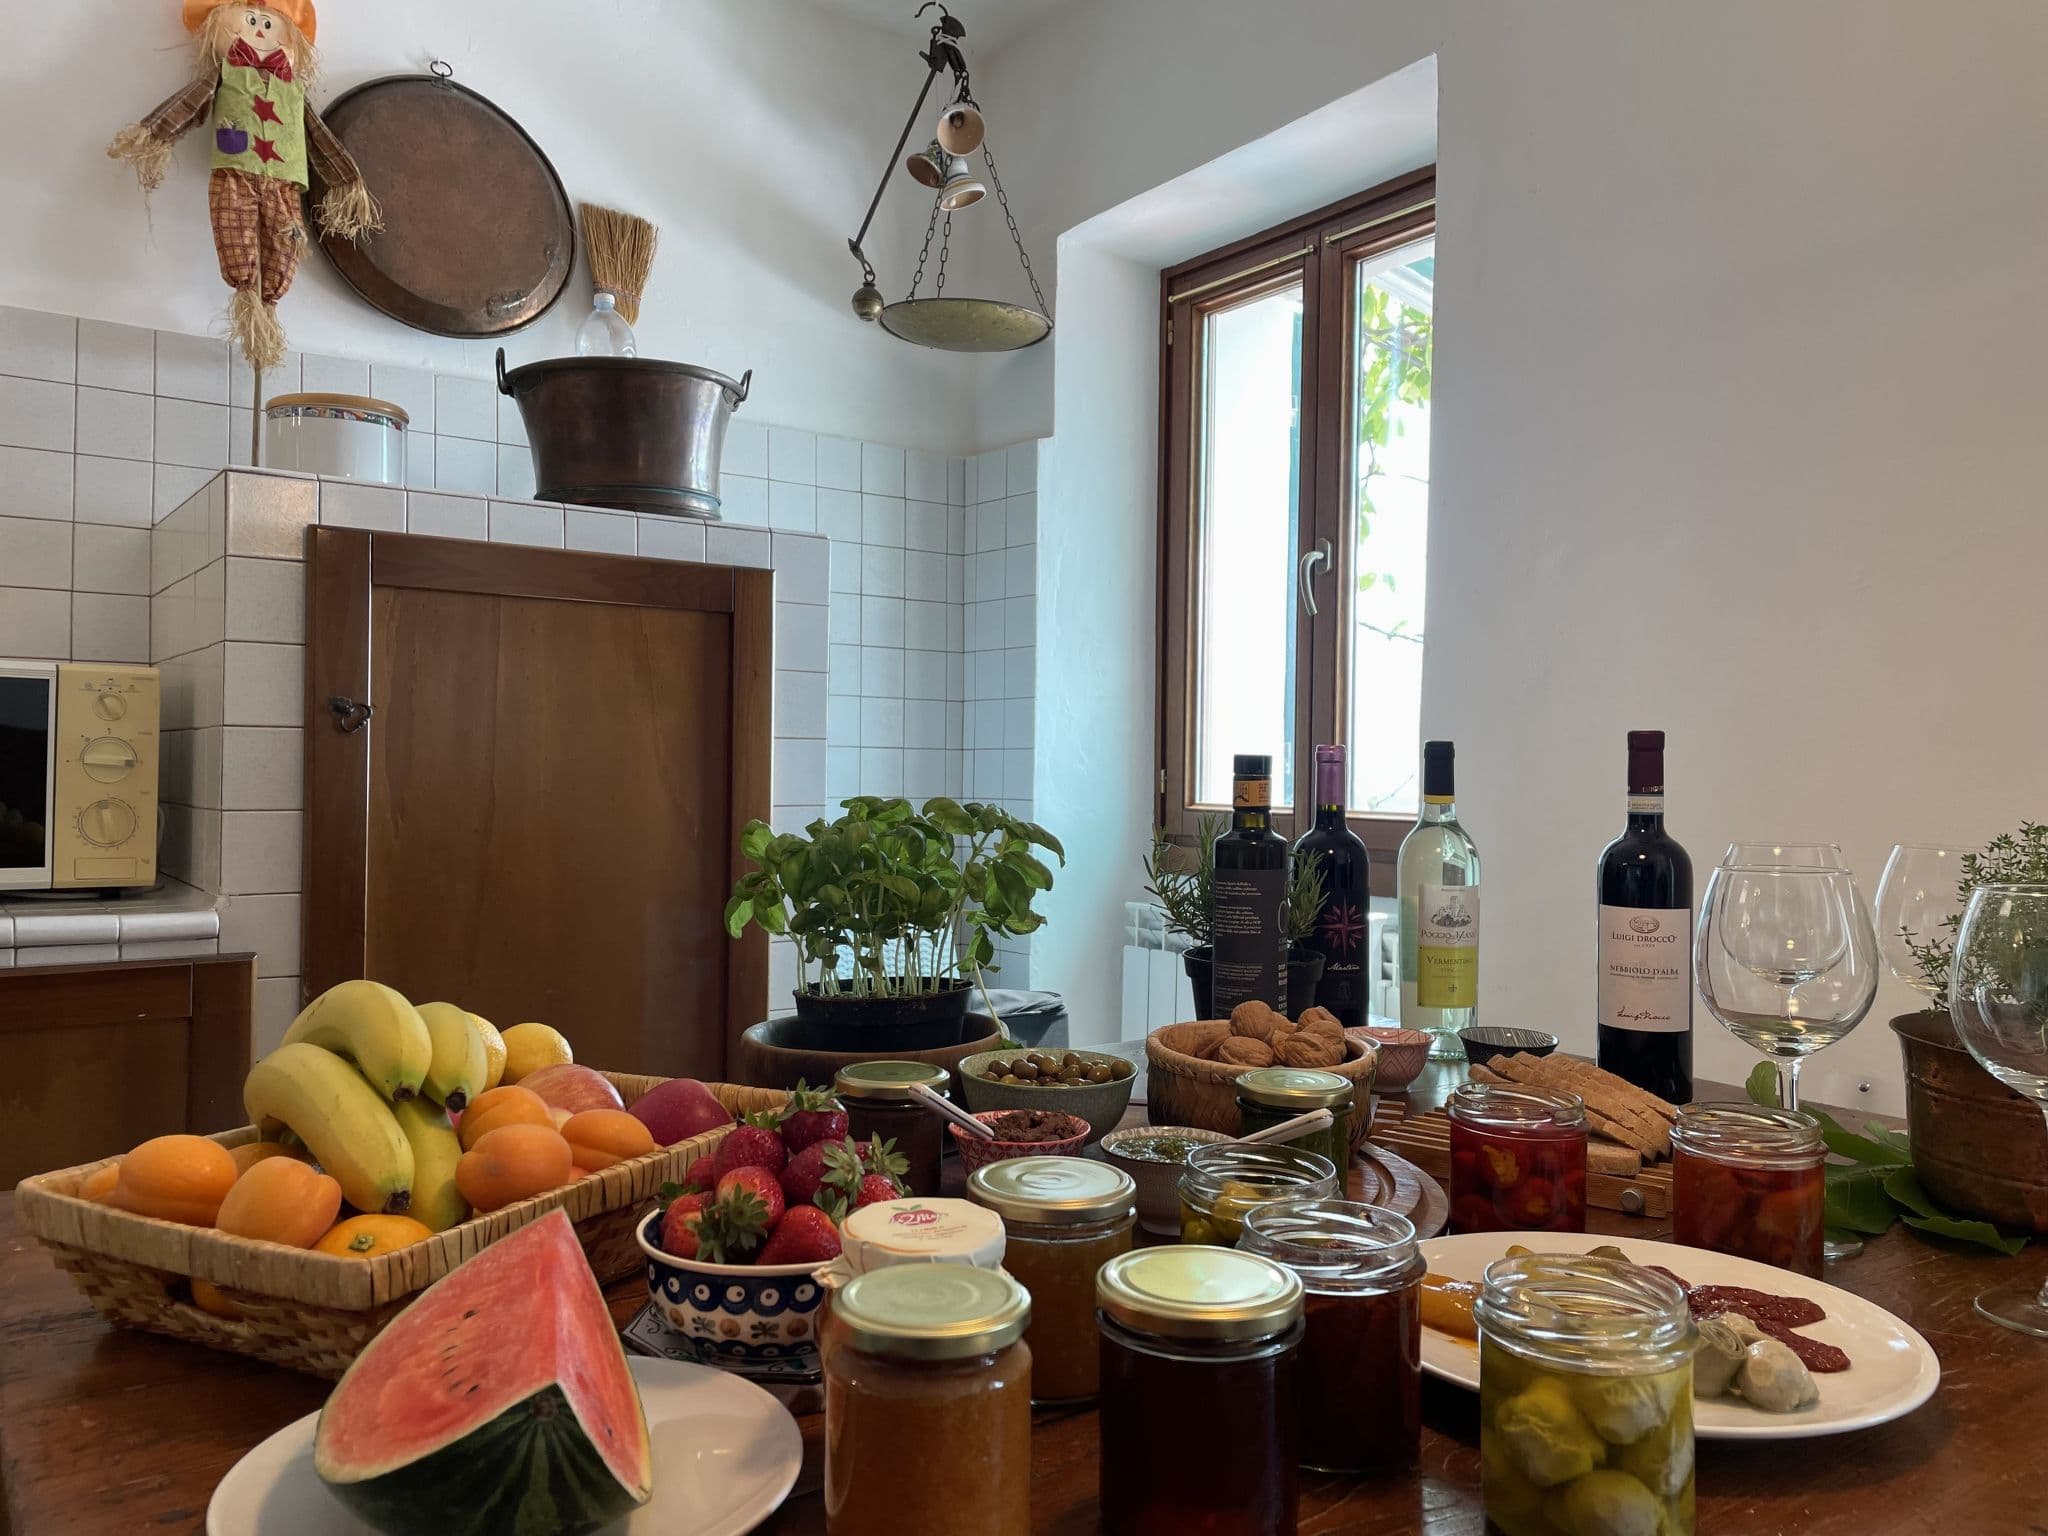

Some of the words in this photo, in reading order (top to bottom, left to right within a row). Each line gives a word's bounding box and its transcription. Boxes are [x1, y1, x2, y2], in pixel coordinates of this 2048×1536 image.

[1612, 930, 1634, 942] LUIGI
[1637, 934, 1676, 944] DROCCO
[1610, 964, 1650, 975] NEBBIOLO
[1652, 968, 1679, 976] D'ALBA
